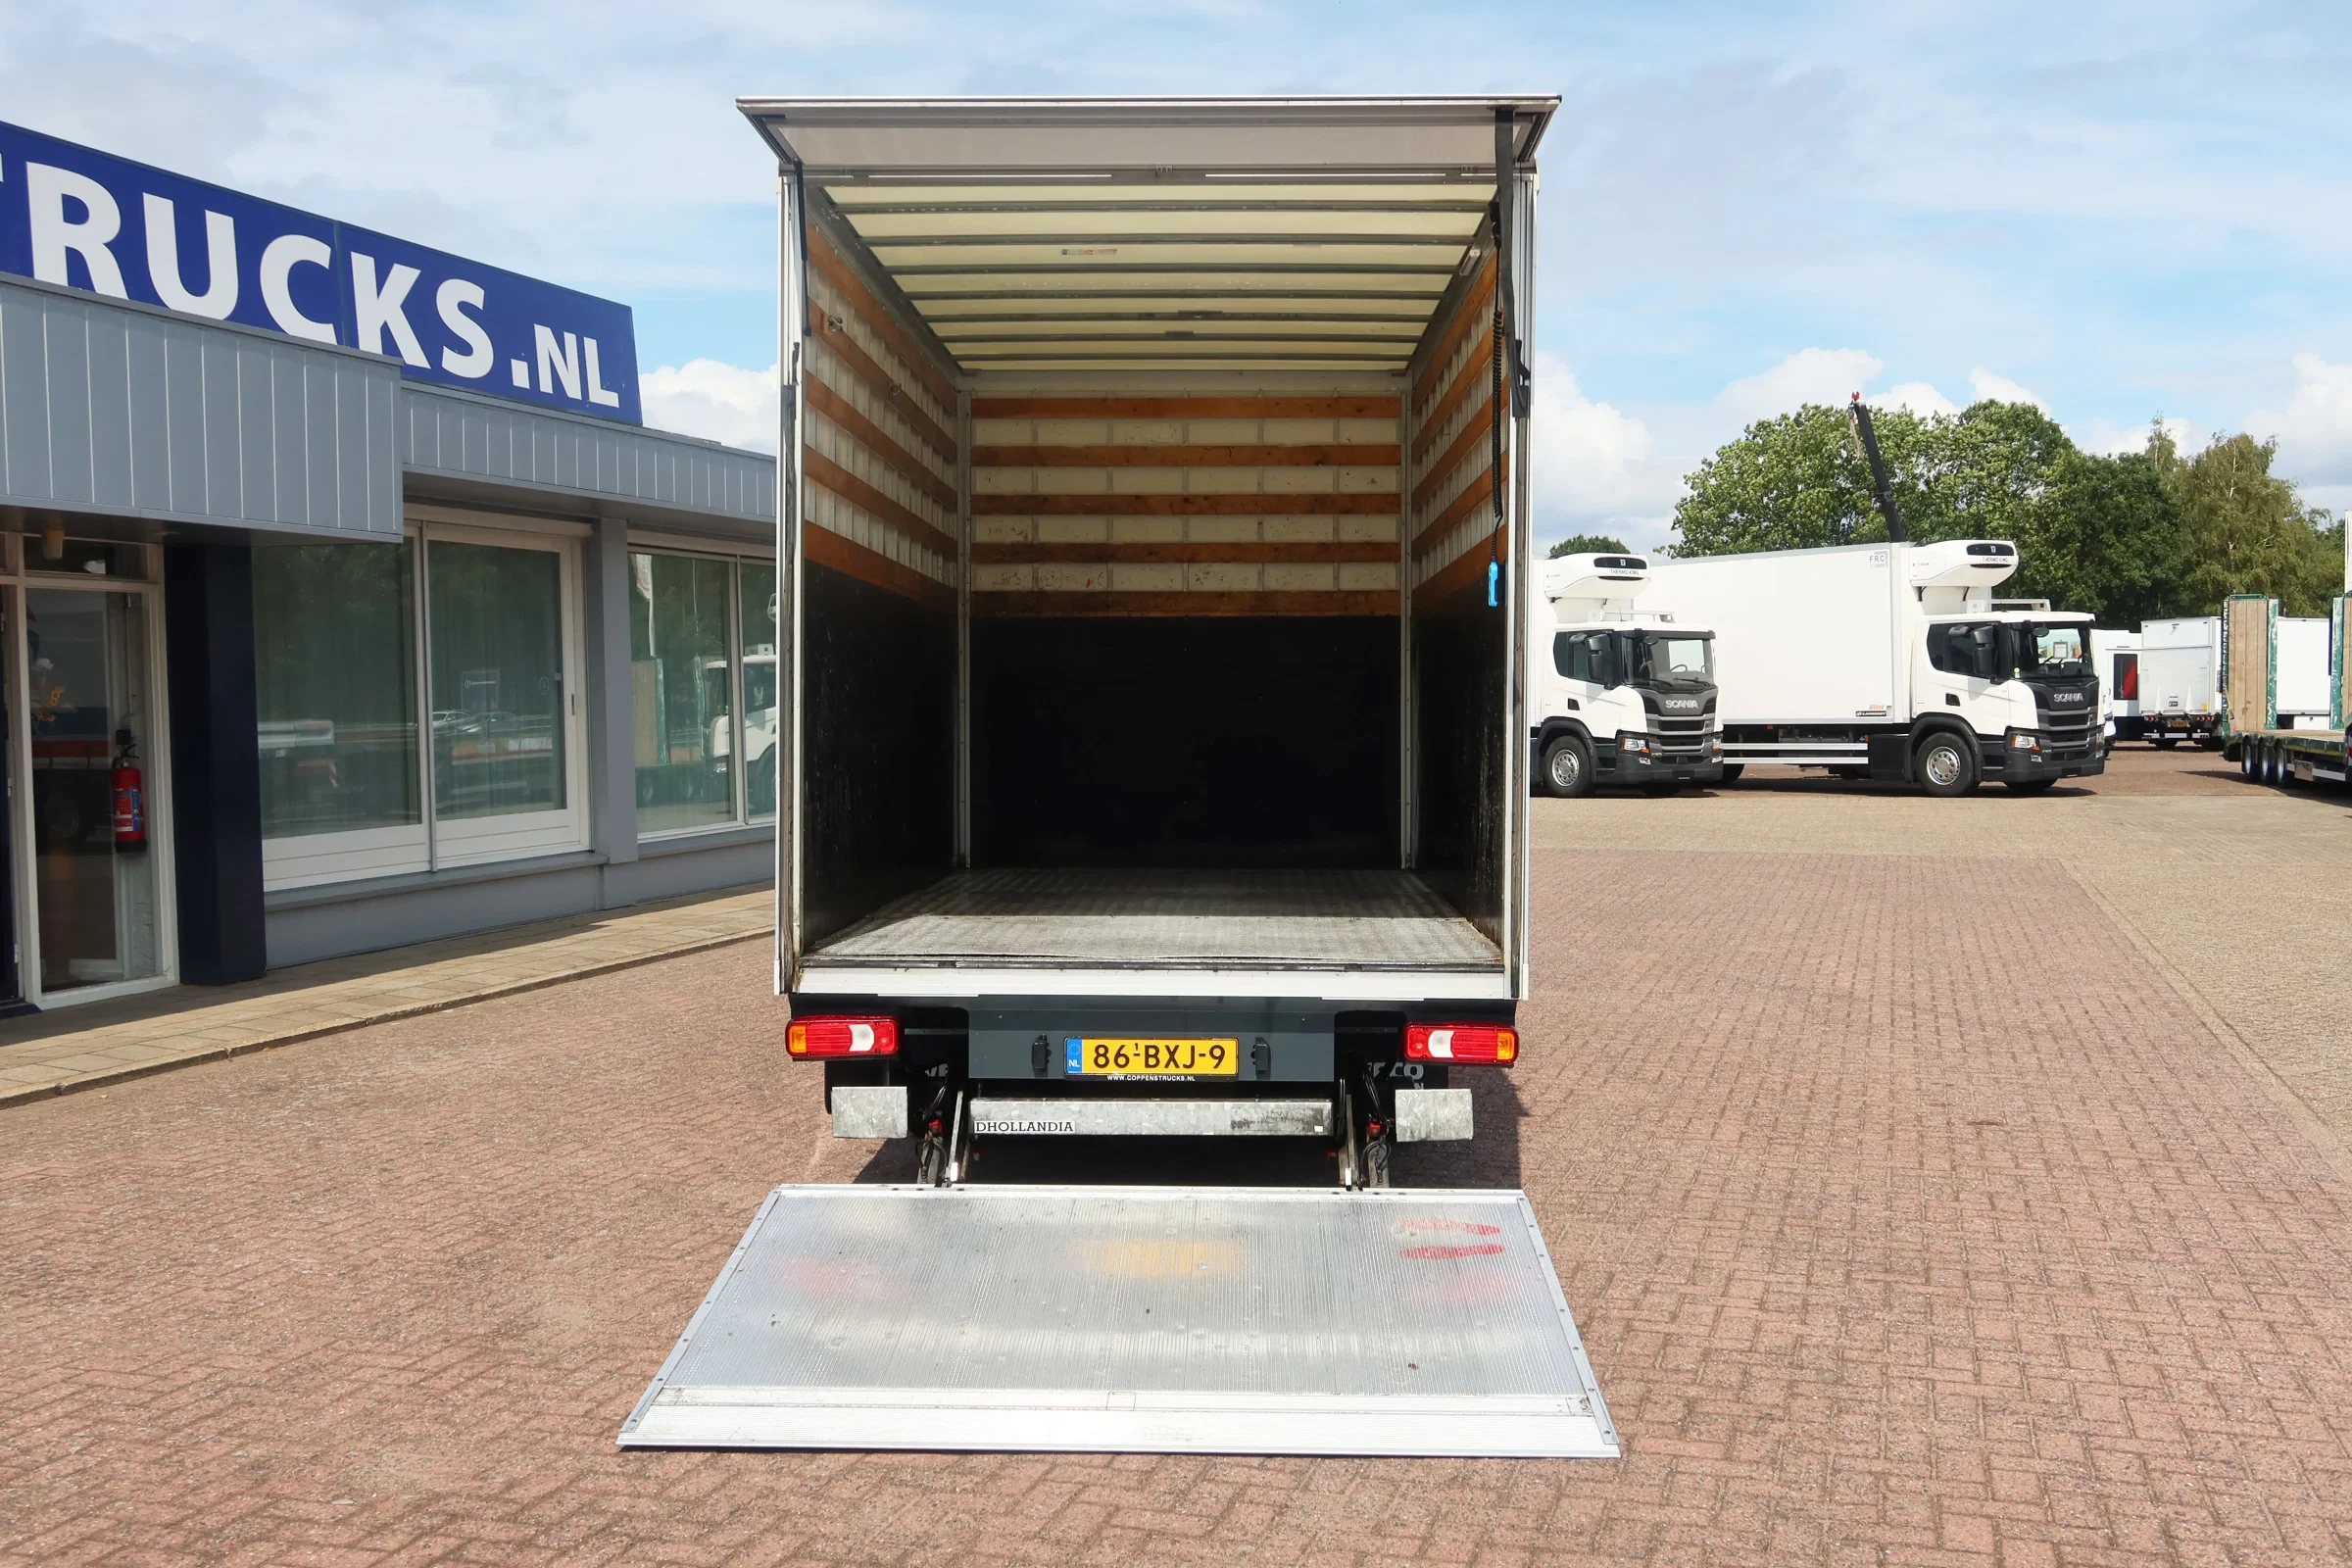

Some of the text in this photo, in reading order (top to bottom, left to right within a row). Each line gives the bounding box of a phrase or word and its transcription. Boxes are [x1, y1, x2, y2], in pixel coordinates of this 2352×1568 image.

[0, 152, 619, 409] RUCKS.NL
[2053, 693, 2083, 703] SCANIA
[1665, 700, 1698, 709] SCANIA
[975, 1121, 1074, 1132] DHOLLANDIA
